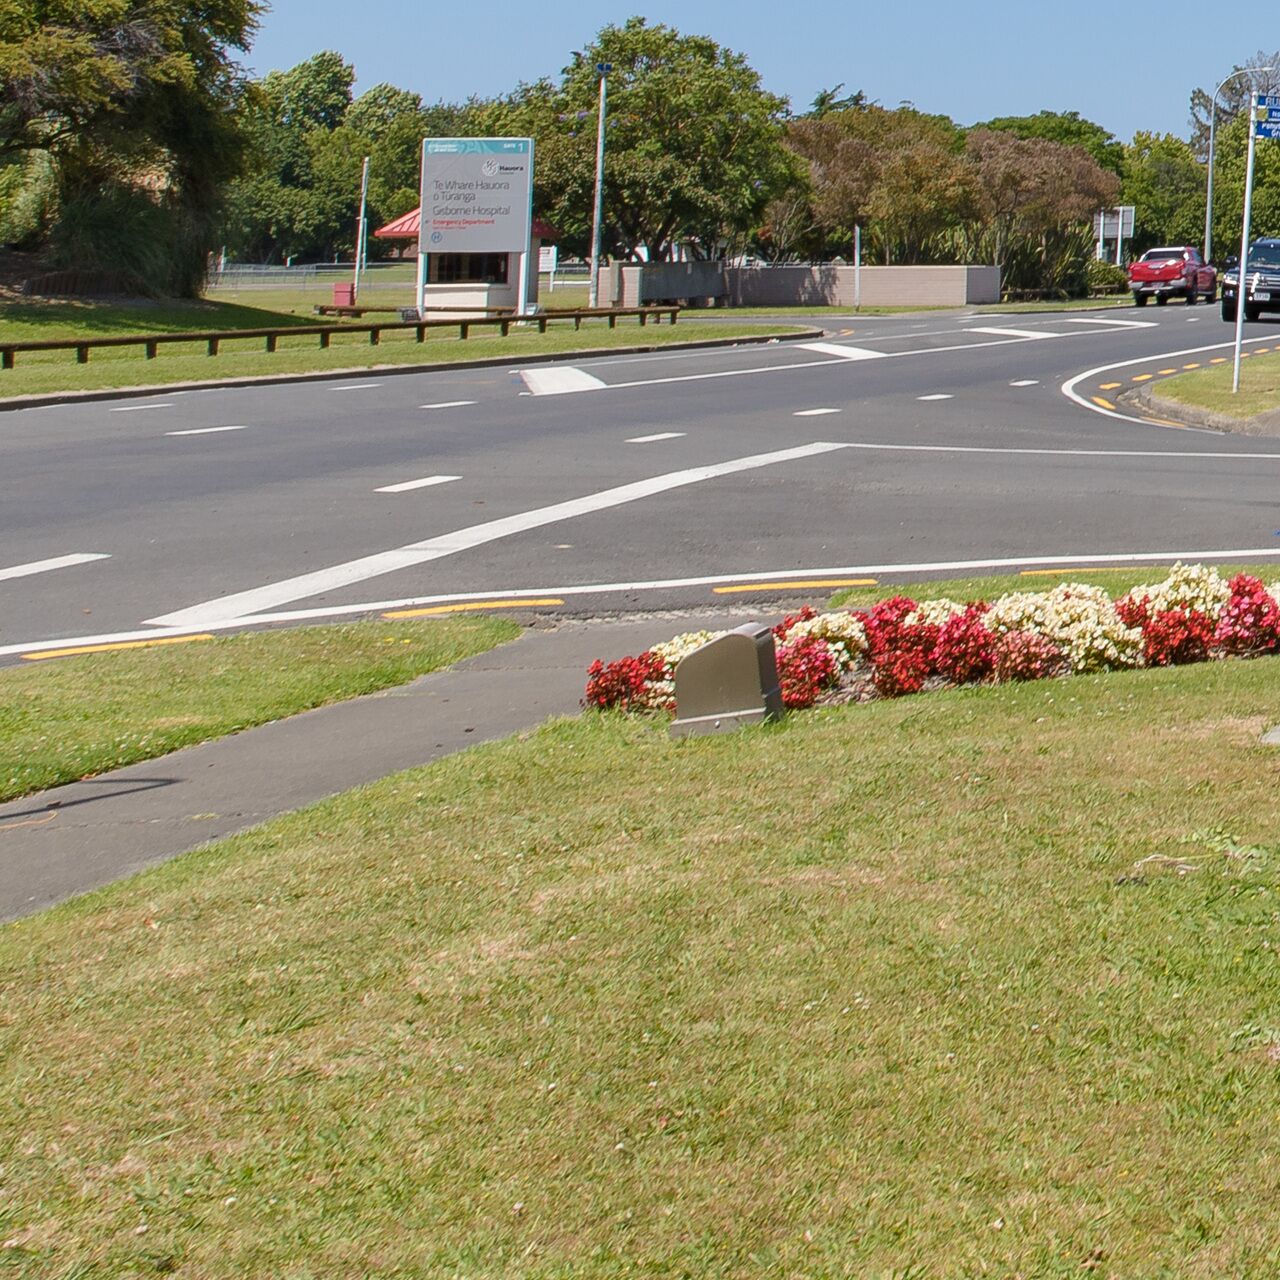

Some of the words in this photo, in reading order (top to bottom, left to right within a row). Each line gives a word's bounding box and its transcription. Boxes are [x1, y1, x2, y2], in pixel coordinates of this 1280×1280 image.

[434, 180, 443, 190] Te
[445, 180, 474, 191] Whare
[476, 181, 510, 191] Hauora
[433, 205, 472, 216] Gisborne
[473, 205, 511, 217] Hospital
